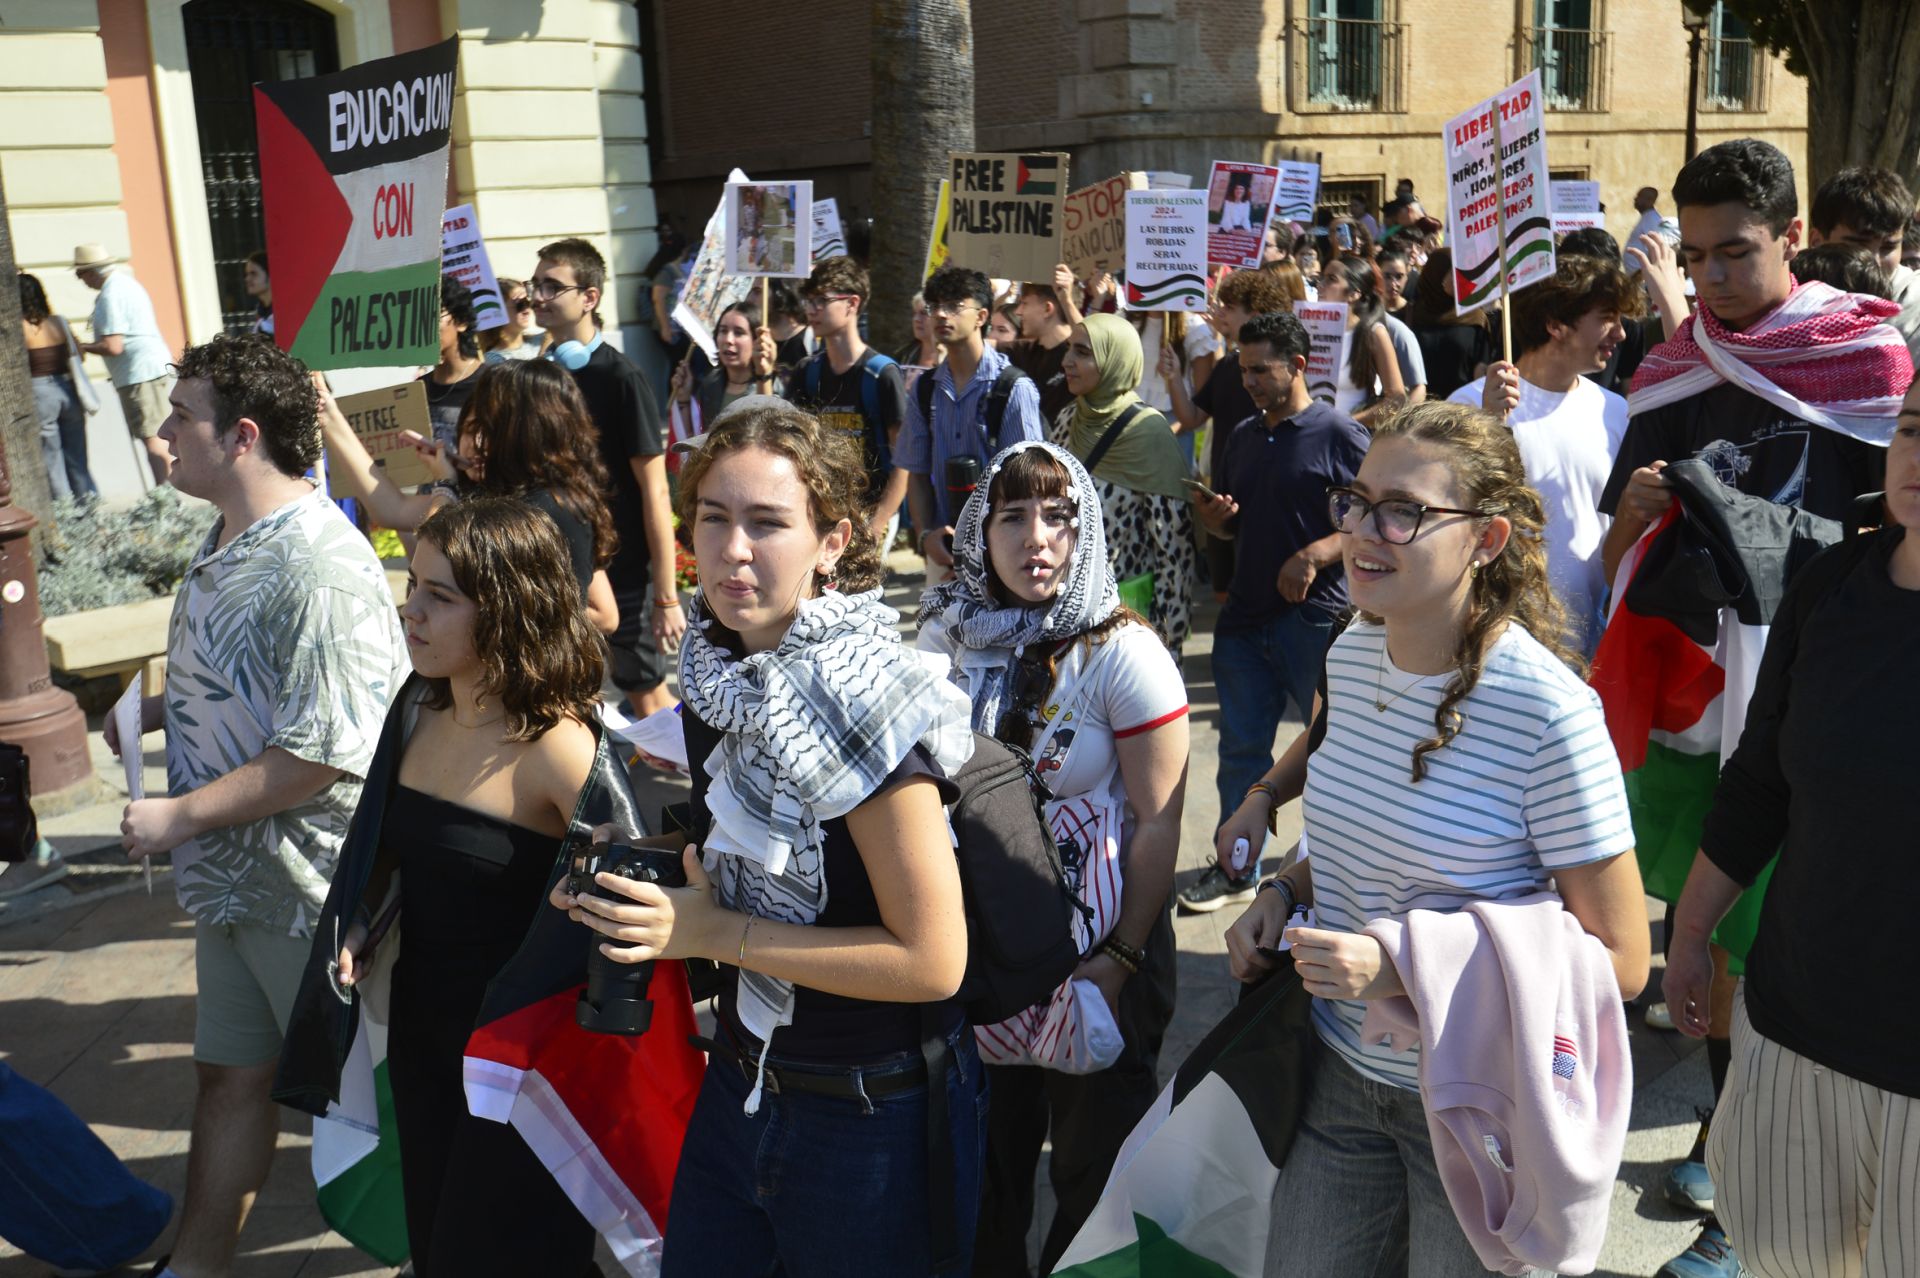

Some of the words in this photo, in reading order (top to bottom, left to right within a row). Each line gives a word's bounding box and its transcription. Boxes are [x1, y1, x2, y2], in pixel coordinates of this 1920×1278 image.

[328, 71, 452, 152] EDUCACION
[953, 158, 1005, 192] FREE
[1459, 173, 1534, 222] PRISIOER@S
[1470, 157, 1526, 196] HOMRES
[373, 182, 414, 240] CON
[952, 198, 1053, 237] PALESTINE
[1064, 177, 1125, 231] STOP
[1466, 194, 1533, 239] PALESIN@S
[1063, 218, 1125, 264] GENOCID
[1140, 225, 1156, 234] LAS
[1158, 225, 1195, 235] TIERRAS
[1136, 261, 1199, 272] RECUPERADAS
[330, 283, 438, 355] PALESTINA
[365, 405, 399, 432] FREE
